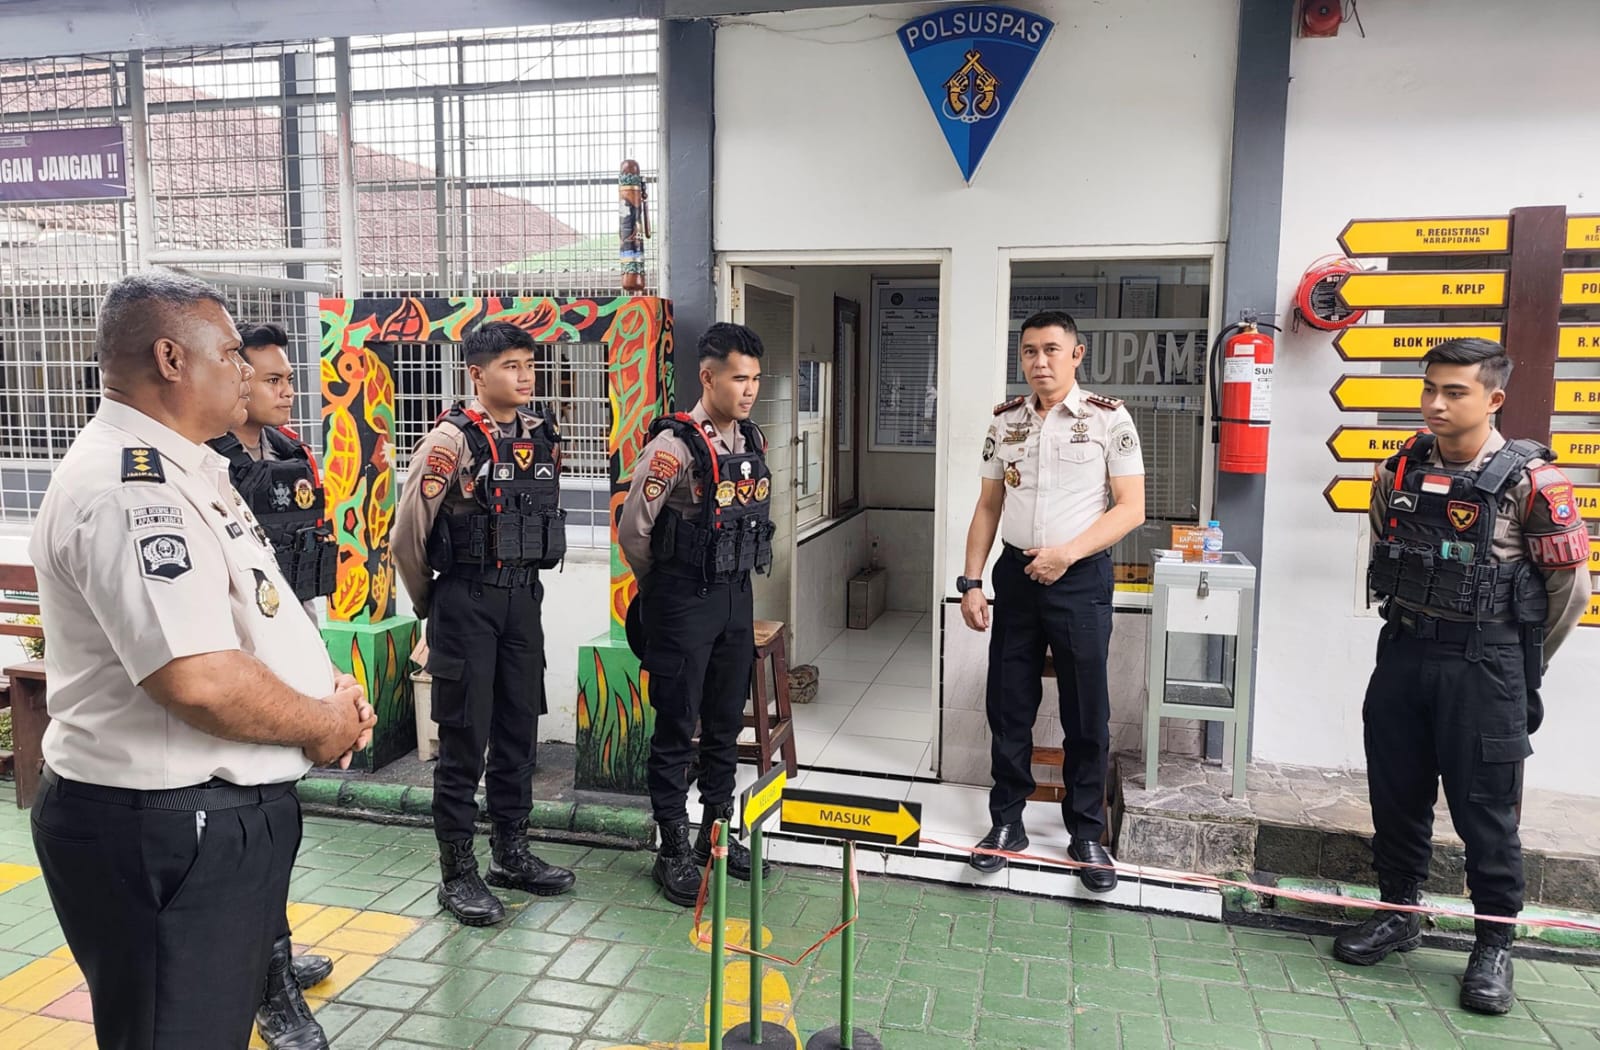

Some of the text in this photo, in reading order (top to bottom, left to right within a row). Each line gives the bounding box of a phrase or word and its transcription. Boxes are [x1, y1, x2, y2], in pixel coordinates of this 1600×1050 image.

[906, 12, 1044, 48] POLSUSPAS
[0, 156, 34, 183] GAN
[37, 154, 103, 182] JANGAN
[1416, 227, 1490, 237] R. REGISTRASI
[1423, 236, 1481, 244] NARAPIDANA
[1442, 283, 1485, 295] R. KPLP
[1581, 283, 1600, 294] PO
[1393, 337, 1423, 348] BLOK
[1578, 336, 1588, 348] R.
[1574, 391, 1600, 402] R. B
[1369, 439, 1379, 450] R.
[1575, 497, 1597, 508] ULA
[819, 809, 872, 826] MASUK
